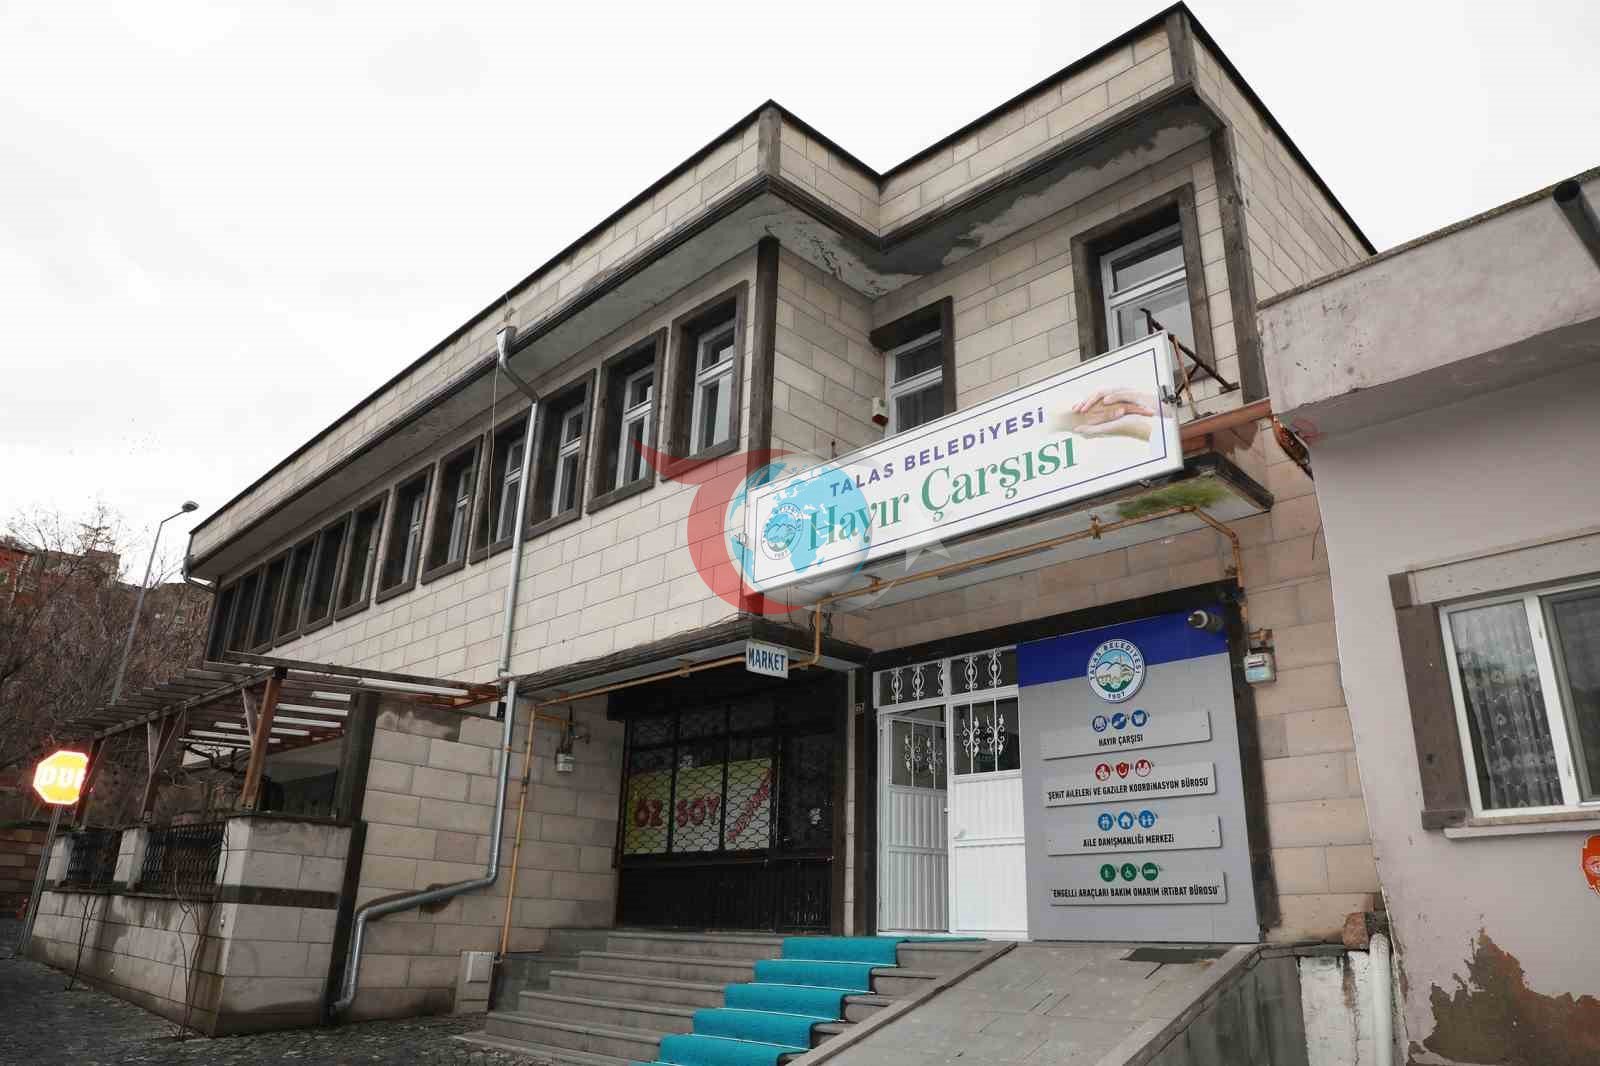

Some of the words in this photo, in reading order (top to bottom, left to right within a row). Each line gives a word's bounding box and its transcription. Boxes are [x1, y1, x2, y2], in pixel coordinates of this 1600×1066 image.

[830, 462, 895, 497] TALAS
[904, 407, 1044, 471] BELEDİYESİ
[808, 492, 909, 551] Hayır
[921, 437, 1078, 522] Çarşısı
[749, 647, 785, 672] MARKET
[1099, 737, 1117, 746] HAYIR
[1093, 786, 1101, 796] VE
[1111, 887, 1132, 897] BAKIM
